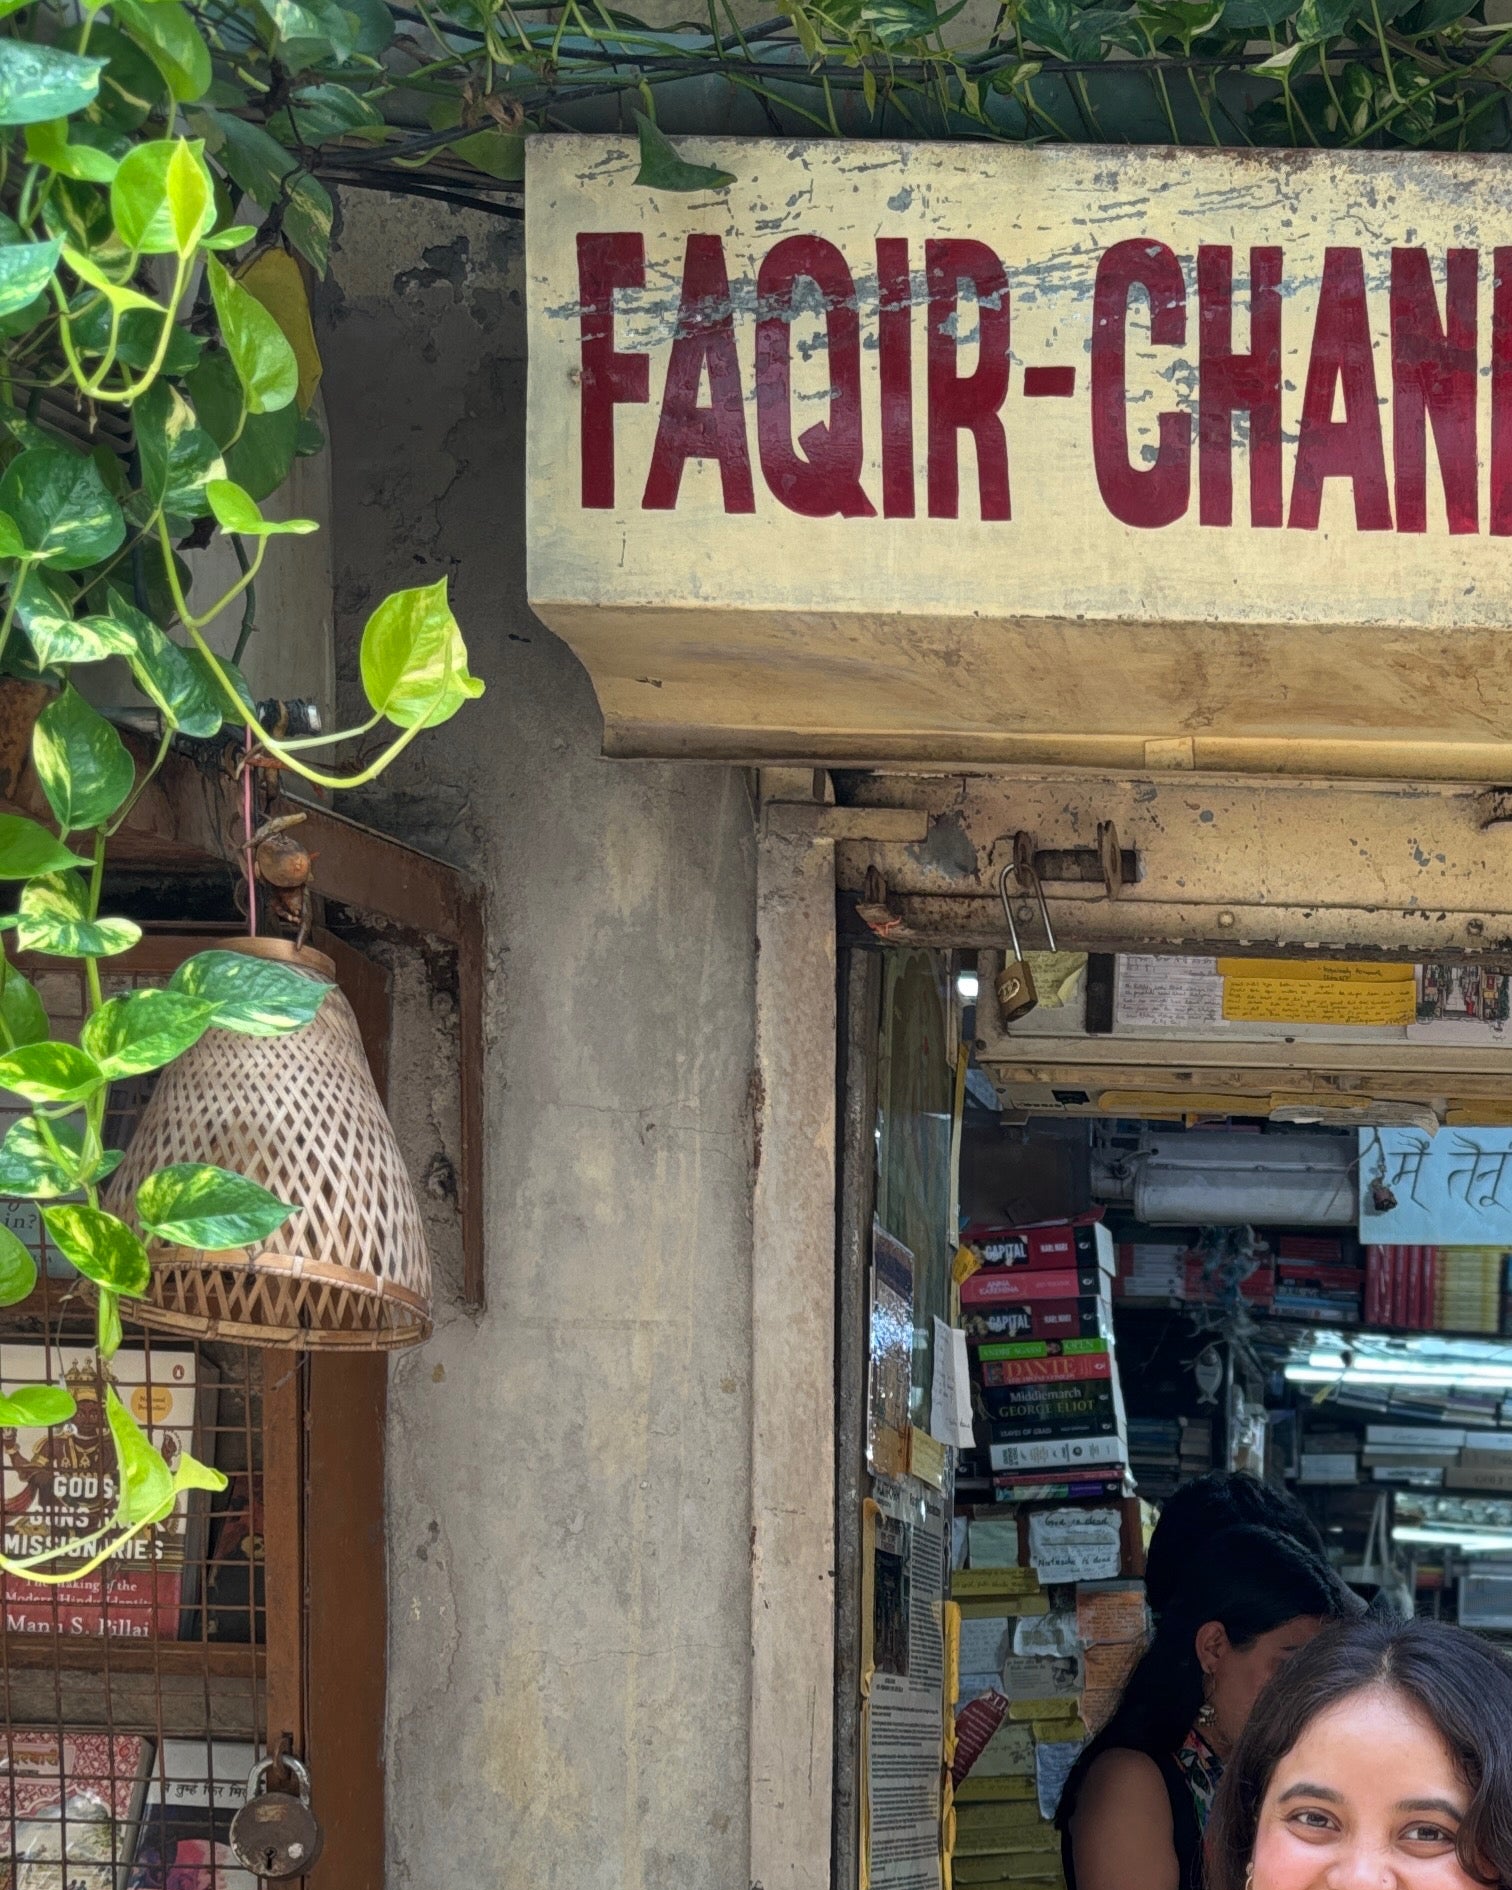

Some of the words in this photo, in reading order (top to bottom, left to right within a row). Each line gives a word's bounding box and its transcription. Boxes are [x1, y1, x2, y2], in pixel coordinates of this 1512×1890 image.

[985, 1243, 1027, 1259] CAPITAL
[988, 1314, 1031, 1330] CAPITAL
[1007, 1359, 1076, 1378] DANTE
[1010, 1386, 1082, 1403] Middlemarch
[1000, 1402, 1051, 1418] GEORGE
[1057, 1400, 1096, 1413] ELIOT
[30, 1505, 91, 1529] GUNS
[5, 1533, 164, 1560] MISSIONRIES
[117, 1579, 138, 1592] the
[70, 1616, 90, 1635] S.
